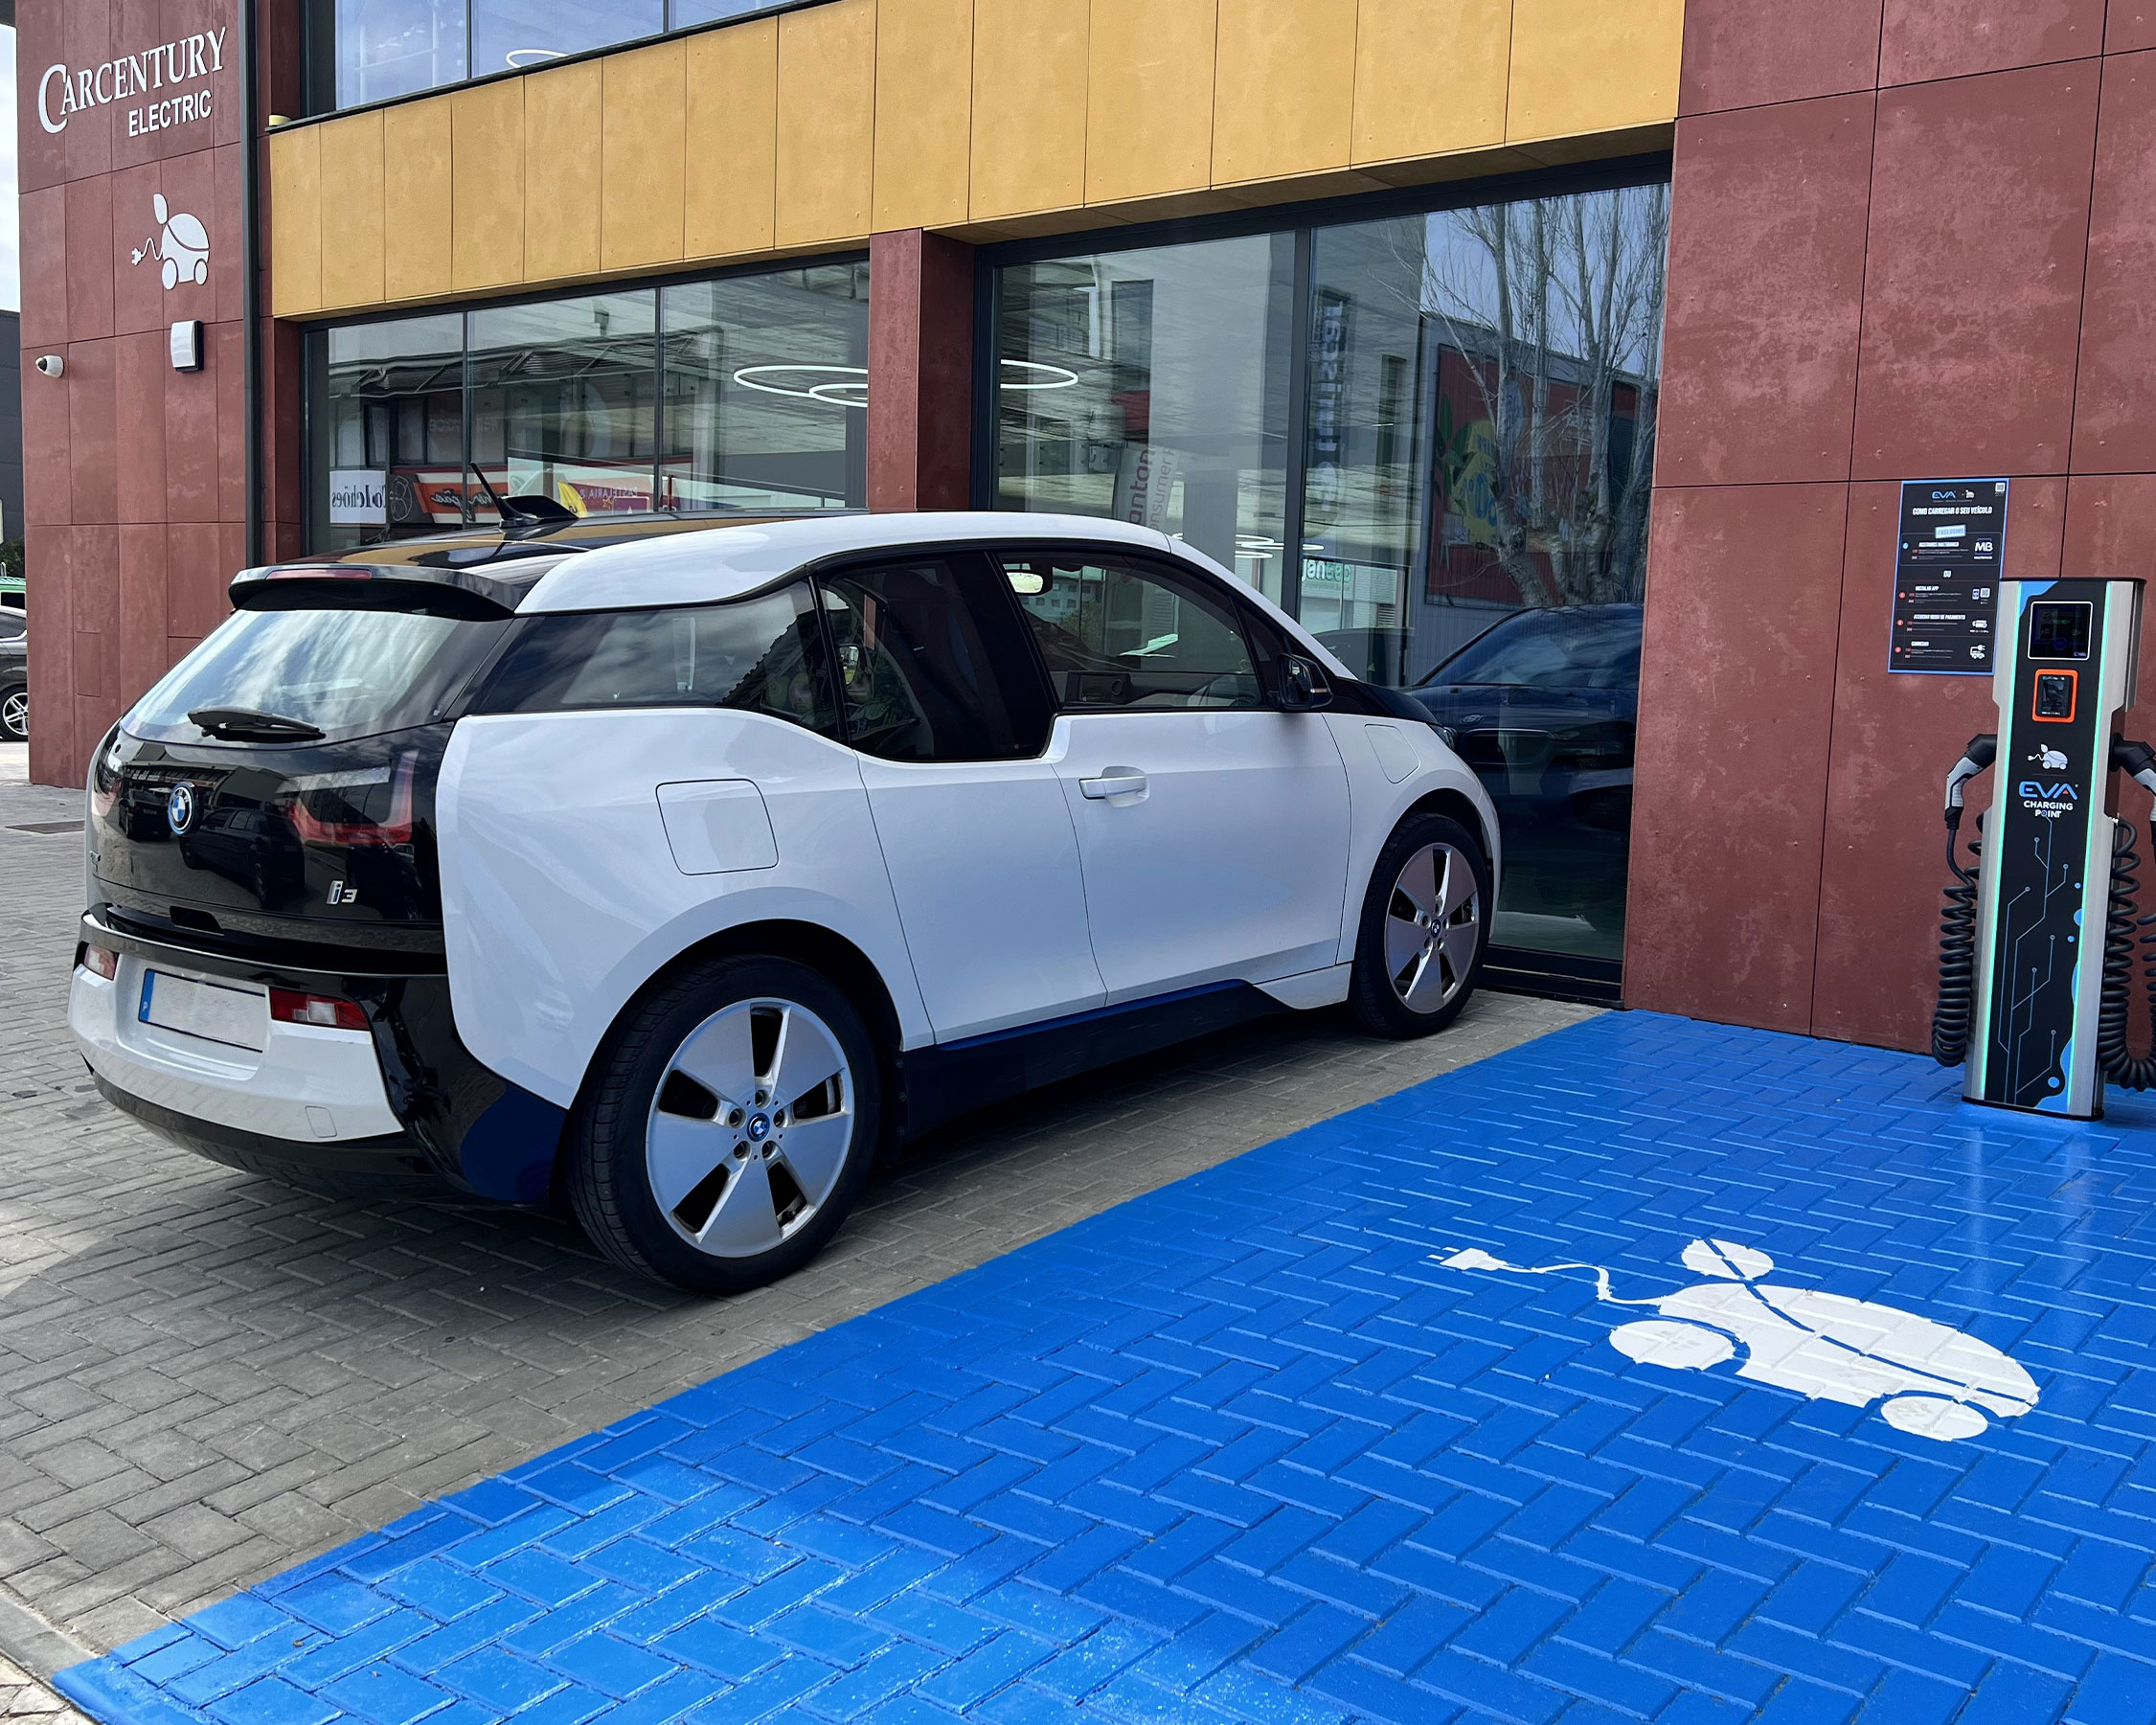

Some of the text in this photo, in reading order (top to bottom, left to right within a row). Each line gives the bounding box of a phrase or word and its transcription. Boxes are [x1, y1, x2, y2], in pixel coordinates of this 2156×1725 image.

[38, 26, 227, 134] CARCENTURY
[128, 89, 213, 138] ELECTRIC
[1148, 458, 1173, 530] onsumer
[1931, 490, 1956, 499] EVA
[1928, 507, 1955, 515] CARREGAR
[1970, 505, 1993, 514] VEÍCULO
[1974, 541, 1993, 552] MB
[2019, 782, 2077, 800] EVA
[2024, 801, 2073, 810] CHARGING
